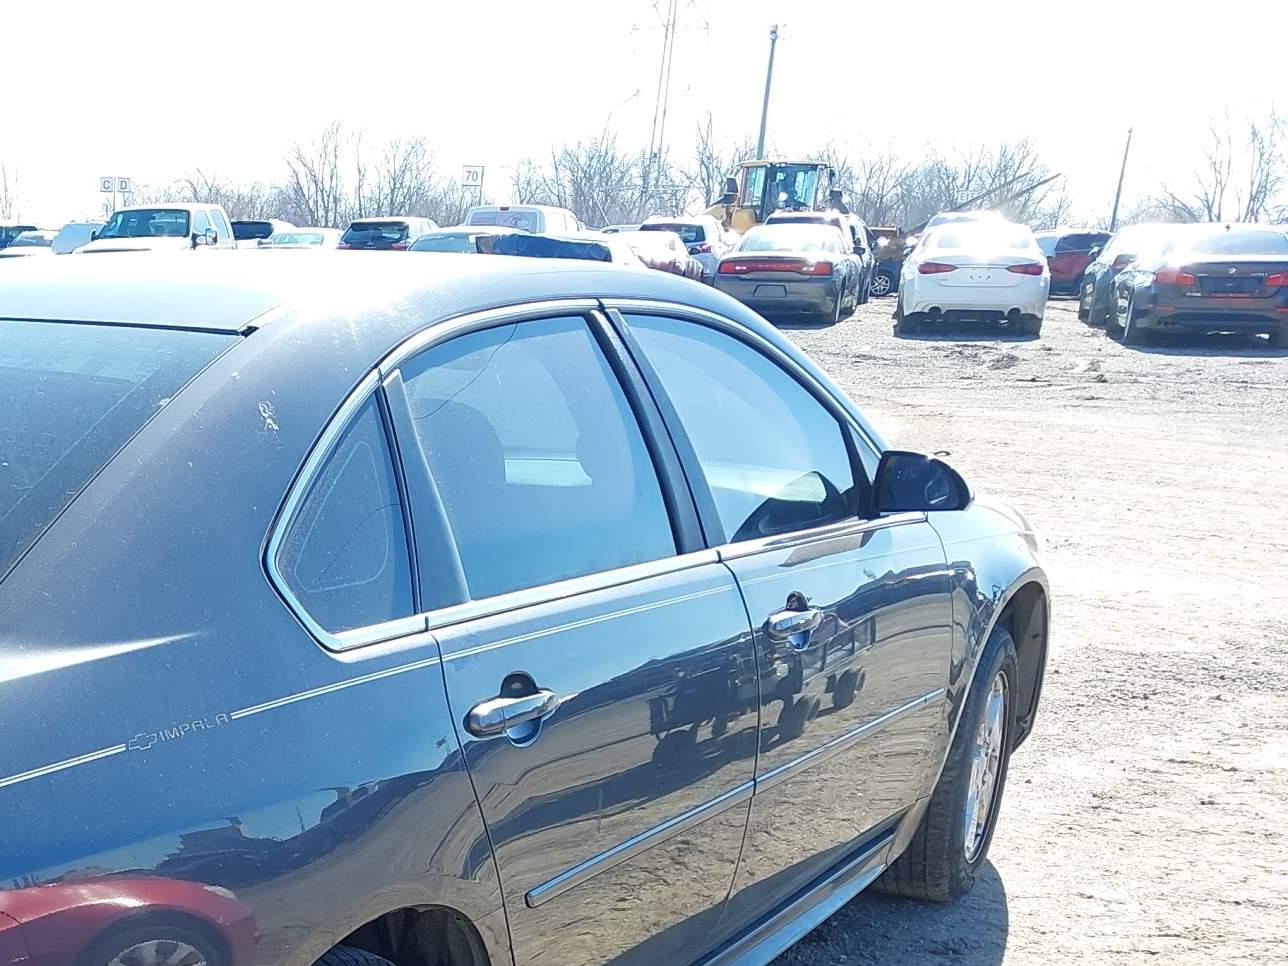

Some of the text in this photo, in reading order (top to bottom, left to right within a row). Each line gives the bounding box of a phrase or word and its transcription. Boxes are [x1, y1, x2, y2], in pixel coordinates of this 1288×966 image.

[465, 170, 479, 182] 70
[103, 179, 111, 190] C
[120, 180, 128, 190] D
[158, 712, 230, 743] IMPALA
